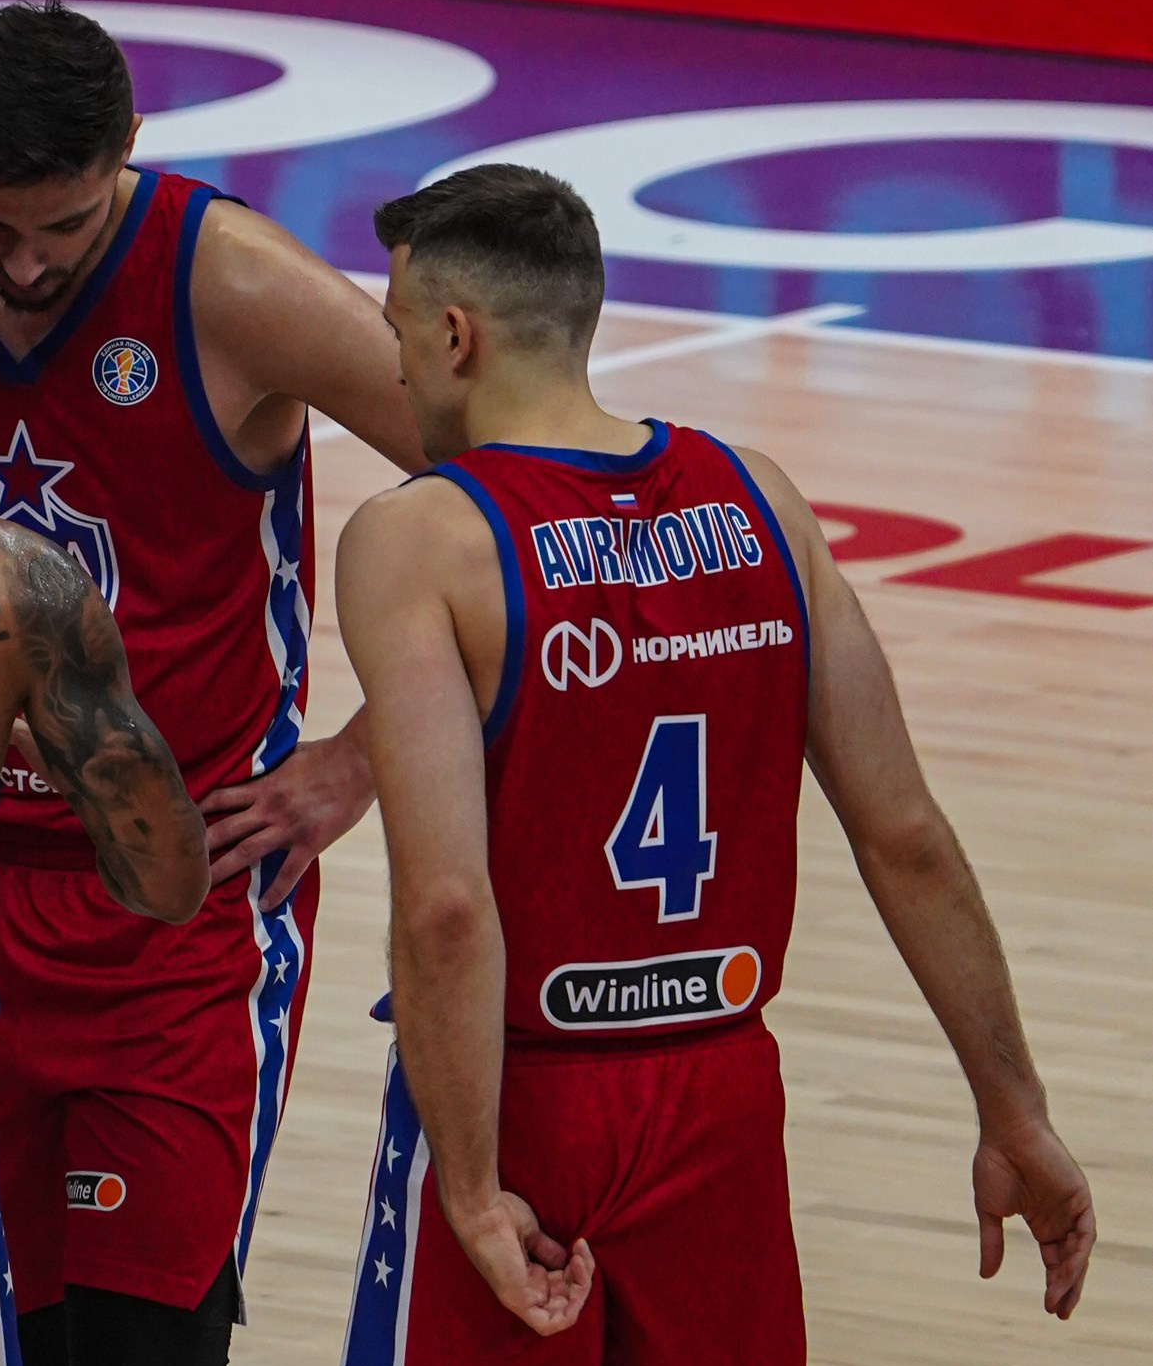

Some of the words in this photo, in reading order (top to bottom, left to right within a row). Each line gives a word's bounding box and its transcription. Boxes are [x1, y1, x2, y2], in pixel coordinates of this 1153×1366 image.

[633, 620, 793, 663] НОРНИКЕЛЬ
[604, 713, 718, 924] 4
[565, 971, 708, 1014] Winline
